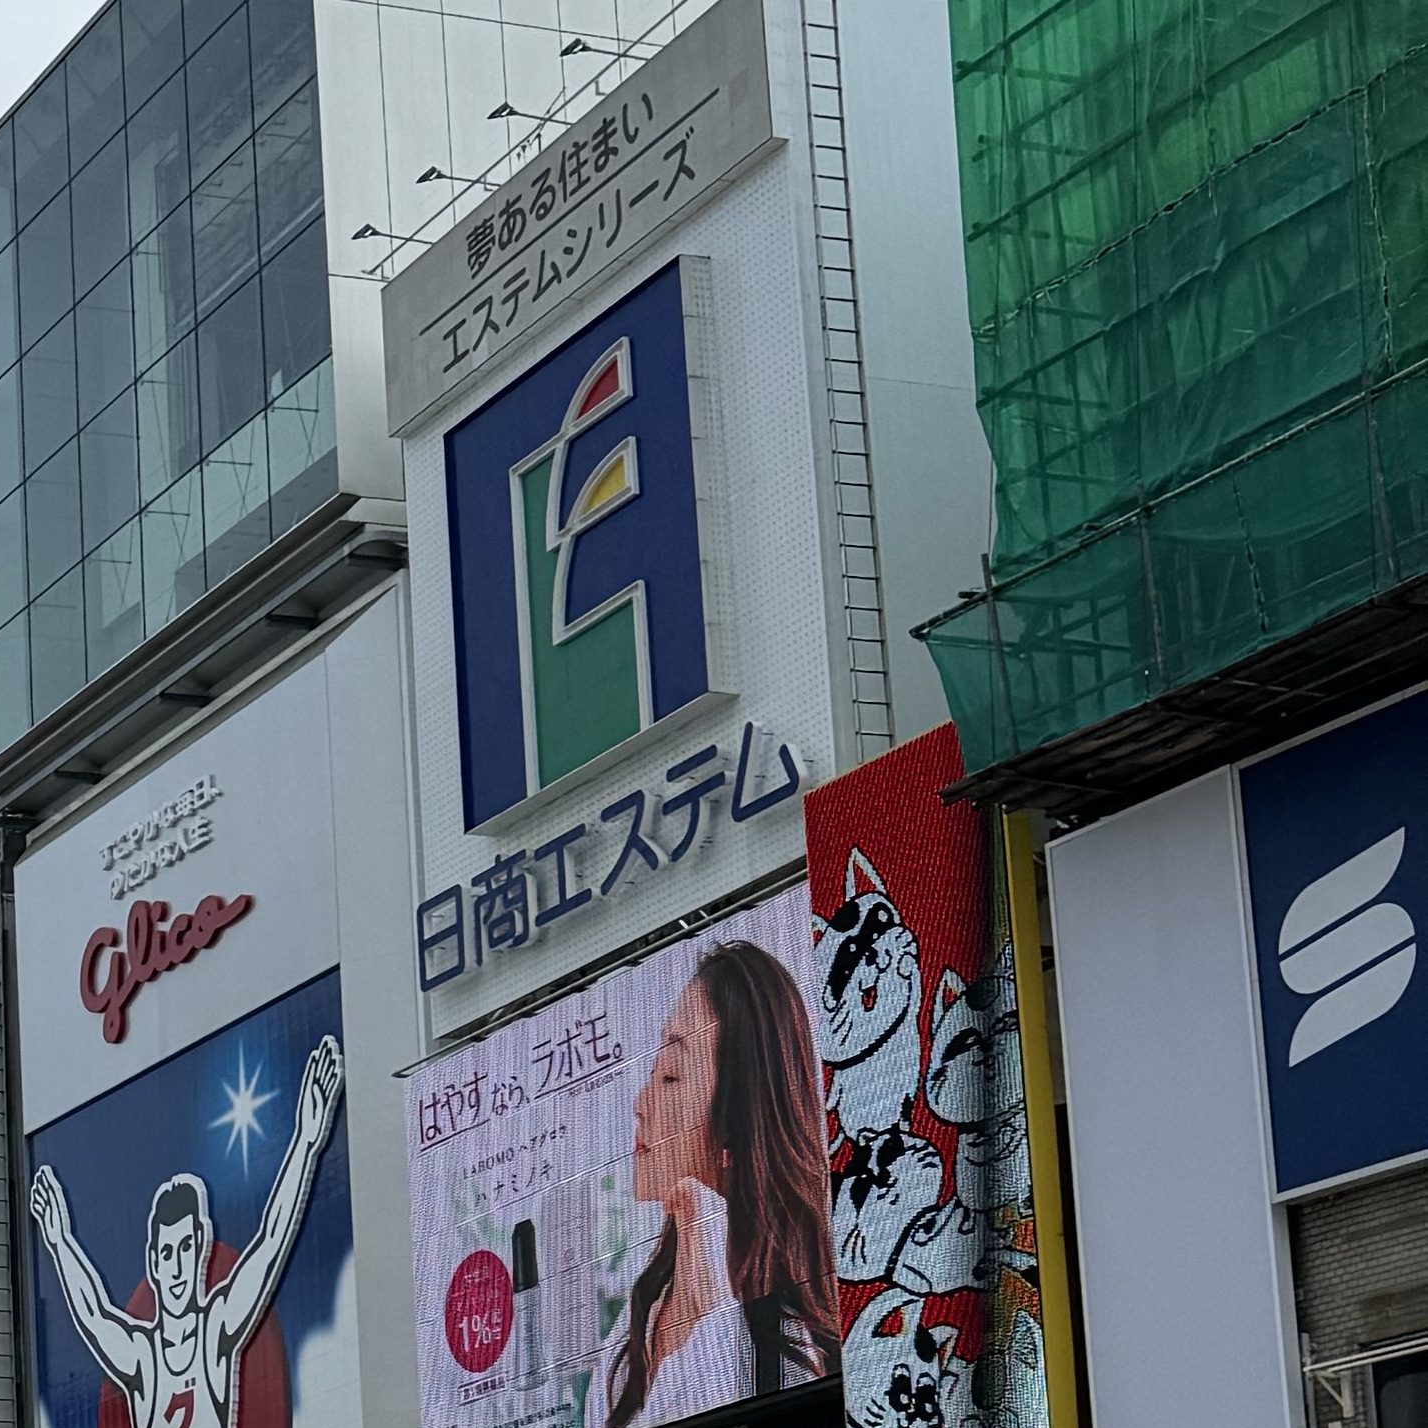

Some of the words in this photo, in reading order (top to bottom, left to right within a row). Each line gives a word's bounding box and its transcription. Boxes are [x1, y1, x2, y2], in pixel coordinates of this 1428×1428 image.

[443, 127, 695, 373] エステムシリーズ
[466, 93, 653, 279] 夢ある住まい
[418, 722, 800, 992] 日商エステム
[79, 894, 255, 1045] Glico
